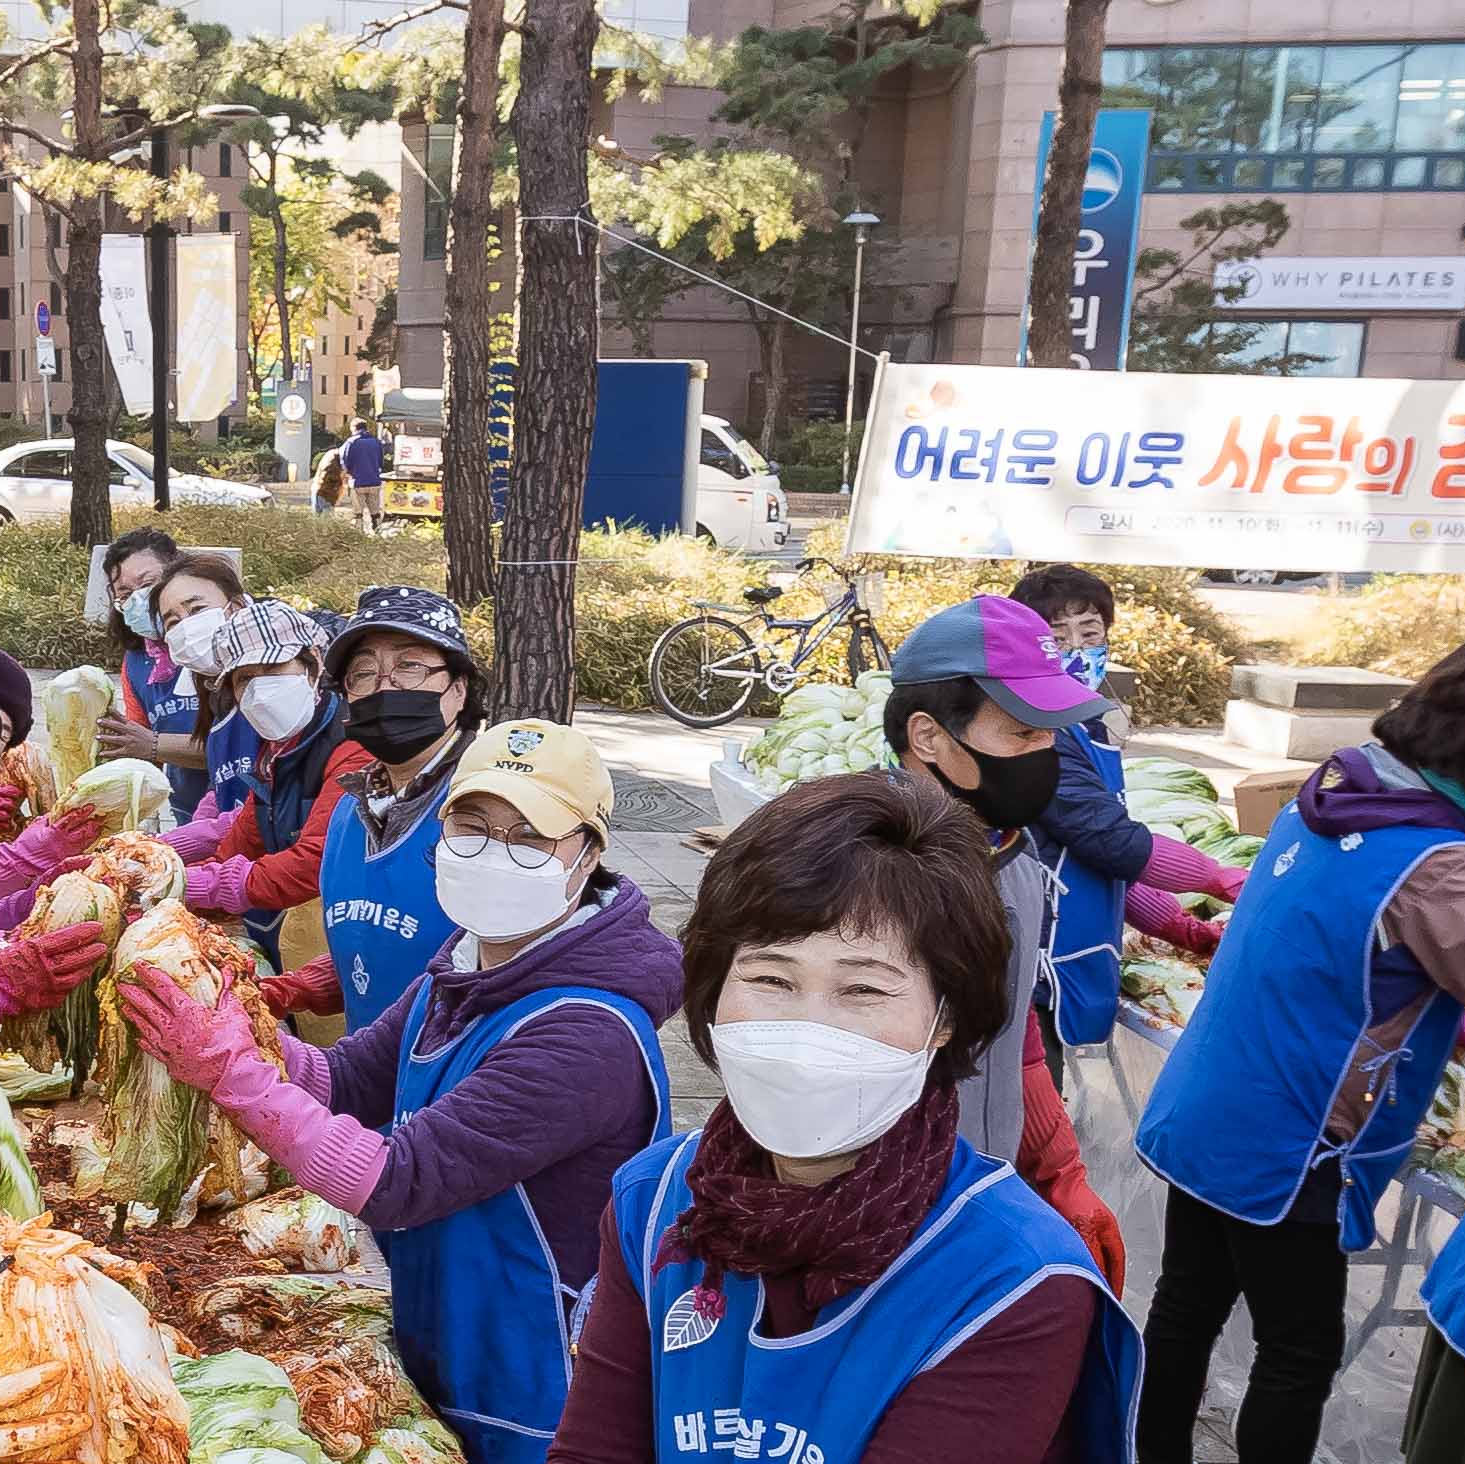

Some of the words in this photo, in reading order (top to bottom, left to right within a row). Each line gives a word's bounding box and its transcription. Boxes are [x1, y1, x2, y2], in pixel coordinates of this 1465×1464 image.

[1271, 272, 1330, 287] WHY
[1338, 271, 1456, 287] PILATES
[1069, 228, 1109, 370] 우리
[894, 424, 1059, 486] 어려운
[1076, 431, 1185, 488] 이웃
[1197, 413, 1416, 496] 사랑의
[1100, 513, 1133, 530] 일시
[495, 760, 535, 773] NYPD
